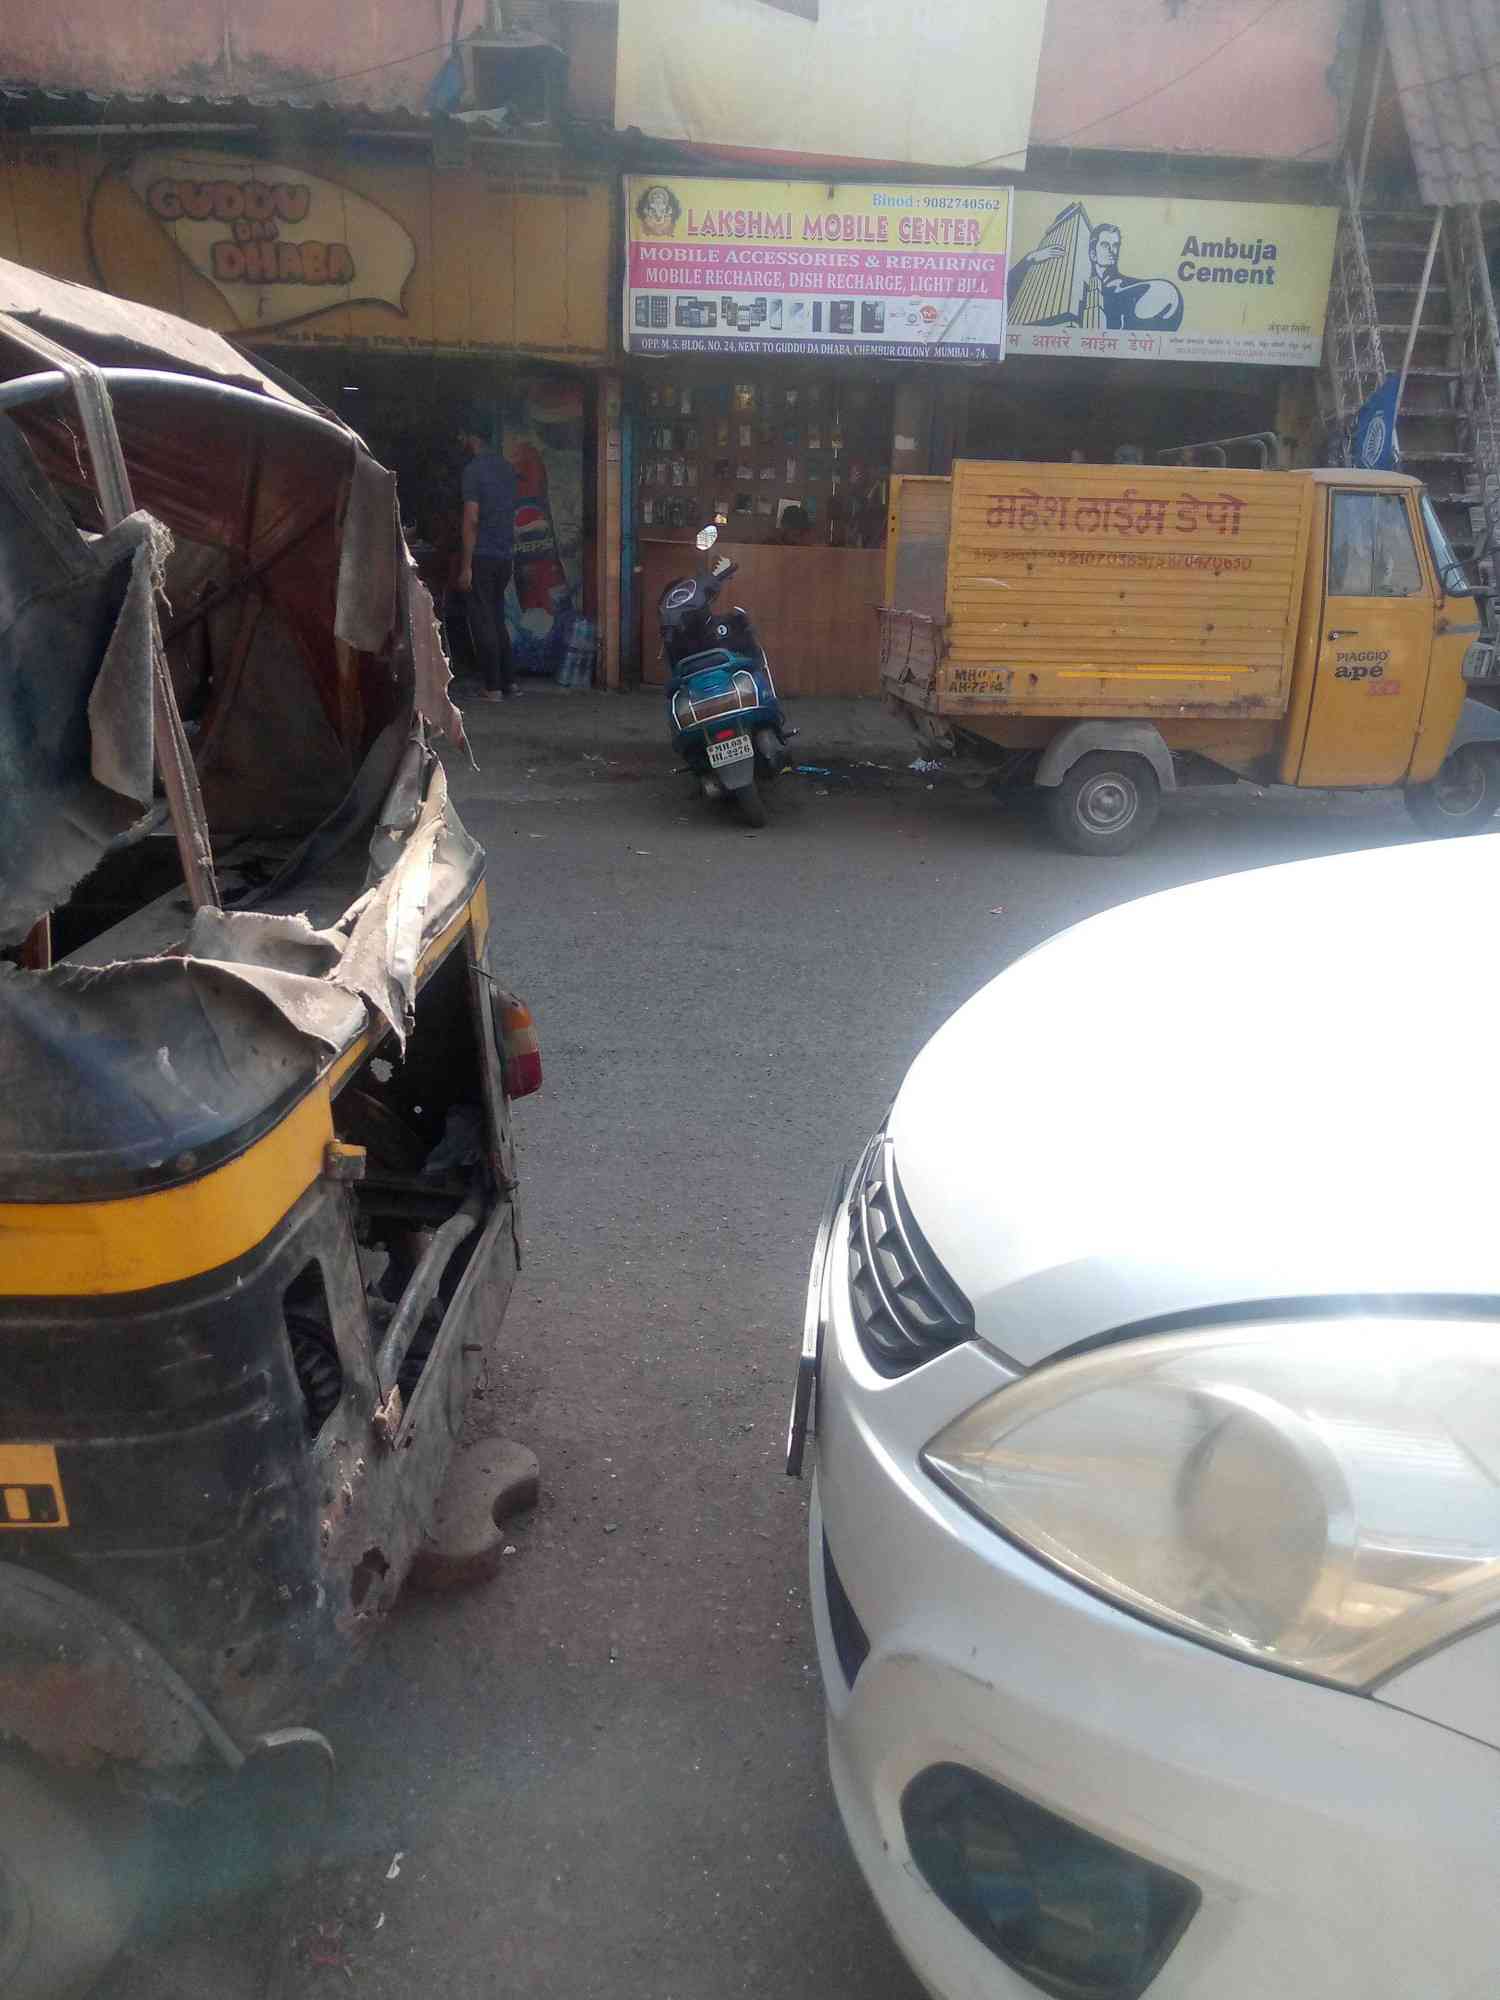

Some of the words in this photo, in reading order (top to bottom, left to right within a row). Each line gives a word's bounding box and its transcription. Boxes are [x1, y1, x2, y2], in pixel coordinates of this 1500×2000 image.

[147, 178, 311, 224] GUDDU
[924, 196, 1000, 210] 9082740562
[688, 208, 793, 239] LAKSHMI
[802, 212, 889, 243] MOBILE
[898, 216, 982, 246] CENTER
[211, 240, 355, 285] DHABA
[639, 246, 720, 263] MOBILE
[725, 251, 860, 268] ACCESSORIES
[864, 255, 880, 268] &
[886, 256, 995, 272] REPAIRING
[1181, 236, 1277, 264] Ambuja
[646, 268, 701, 284] MOBILE
[706, 270, 784, 288] RECHARGE,
[789, 272, 823, 288] DISH
[827, 273, 906, 292] RECHARGE,
[910, 276, 951, 292] LIGHT
[958, 278, 988, 293] BILL
[1177, 261, 1275, 284] Cement
[738, 341, 760, 352] NEXT
[763, 342, 774, 352] TO
[776, 342, 806, 353] GUDDU
[854, 344, 895, 356] CHEMBUR
[935, 347, 969, 358] MUMBAI
[1336, 651, 1388, 661] PIAGGIO
